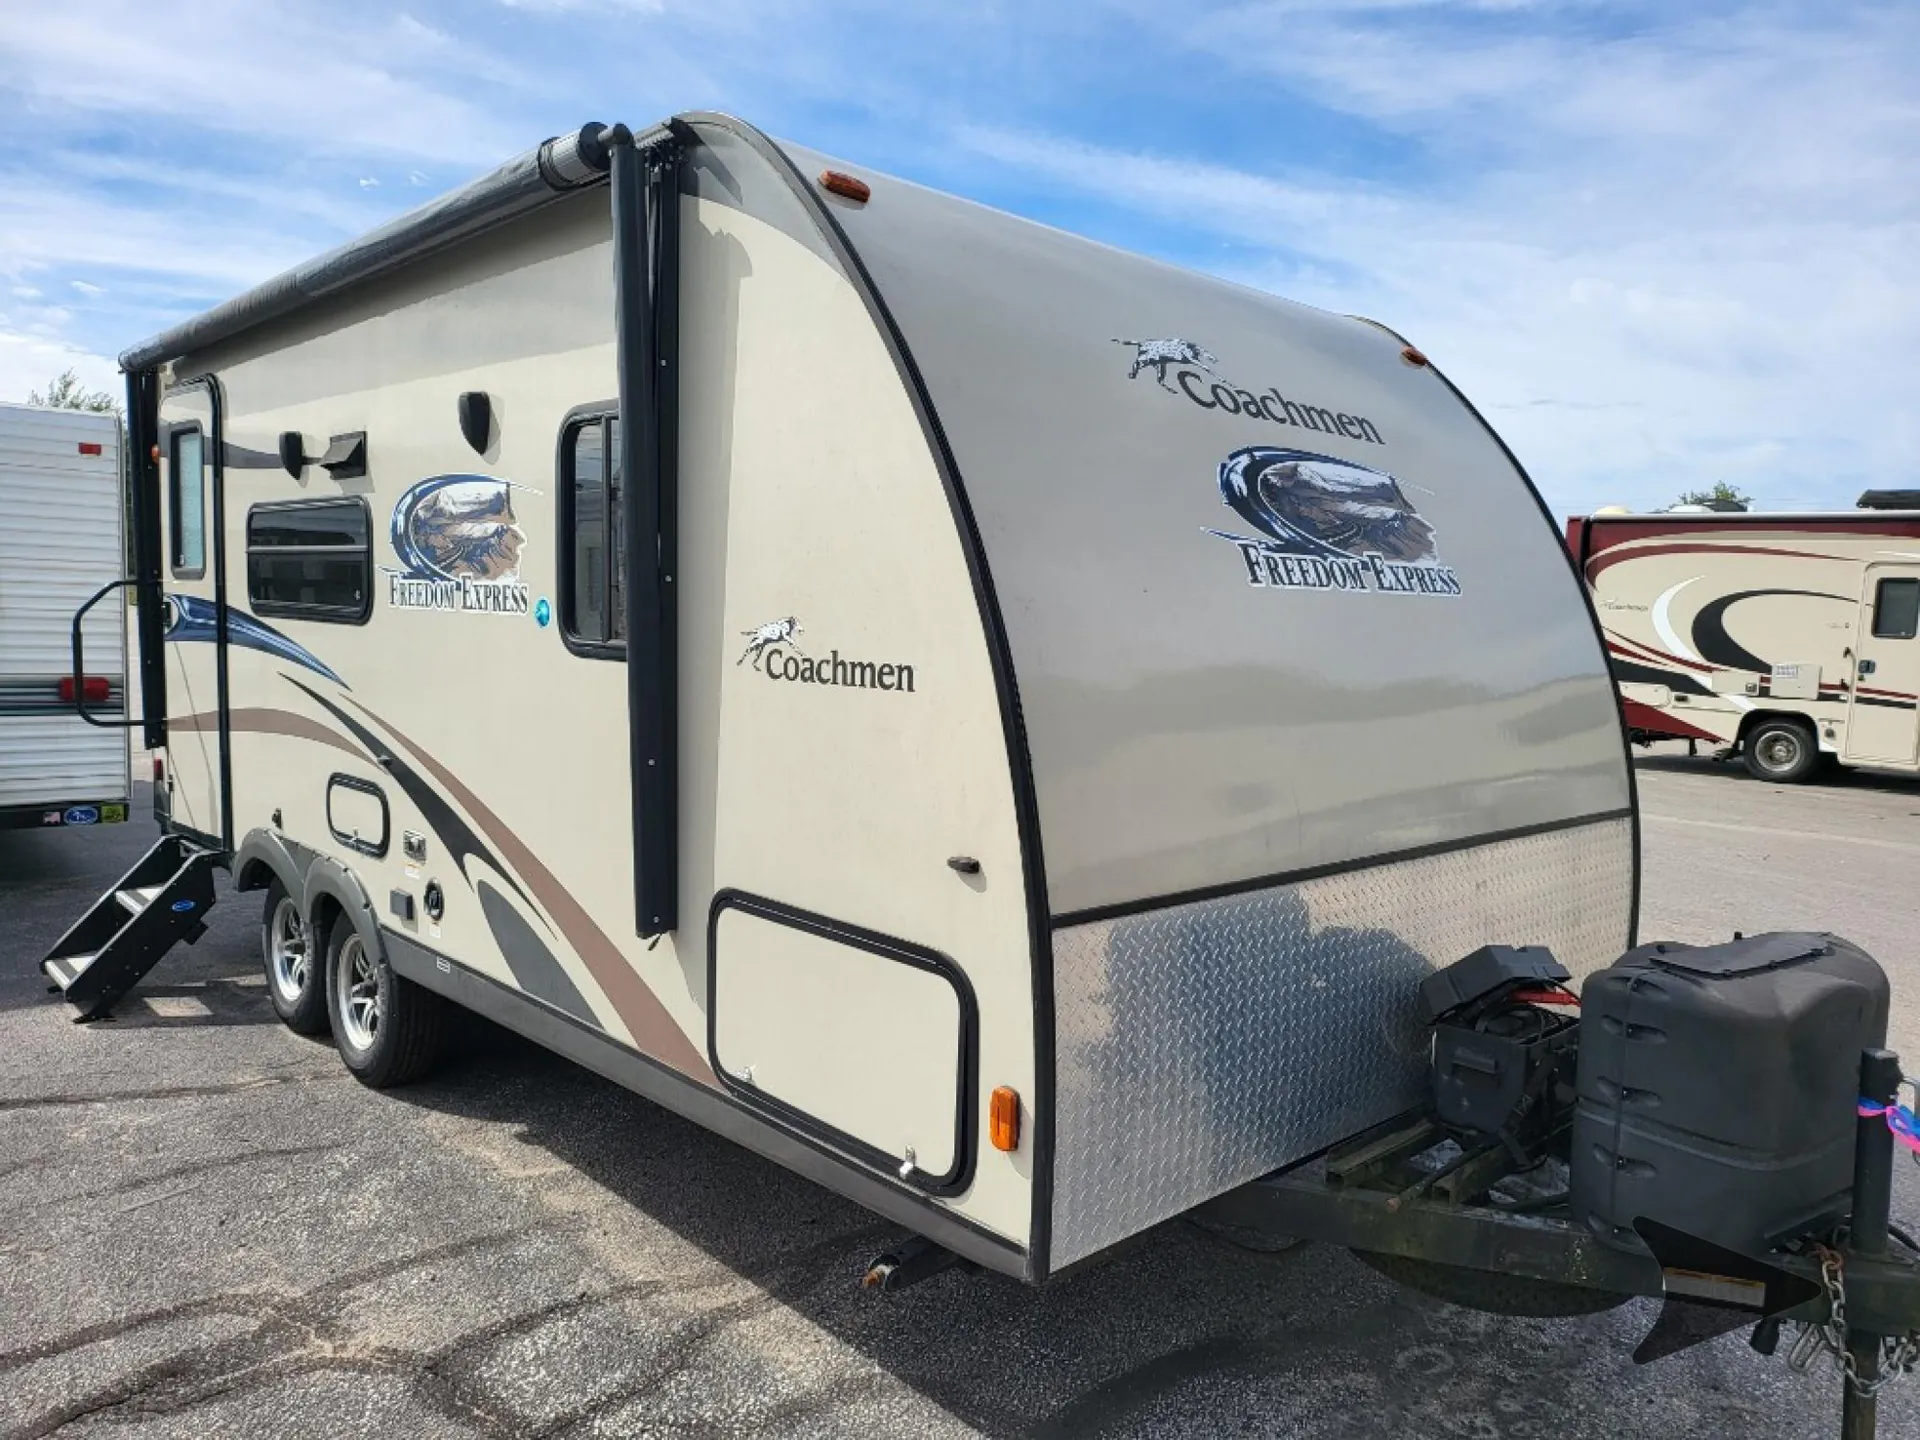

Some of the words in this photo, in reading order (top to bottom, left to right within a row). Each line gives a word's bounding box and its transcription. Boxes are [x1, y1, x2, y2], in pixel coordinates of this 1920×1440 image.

[1177, 370, 1386, 445] Coachmen
[1239, 543, 1368, 590] FREEDOM
[1366, 554, 1462, 595] EXPRESS
[389, 574, 455, 609] FREEDOM
[461, 575, 528, 614] EXPRESS
[766, 648, 916, 692] Coachmen
